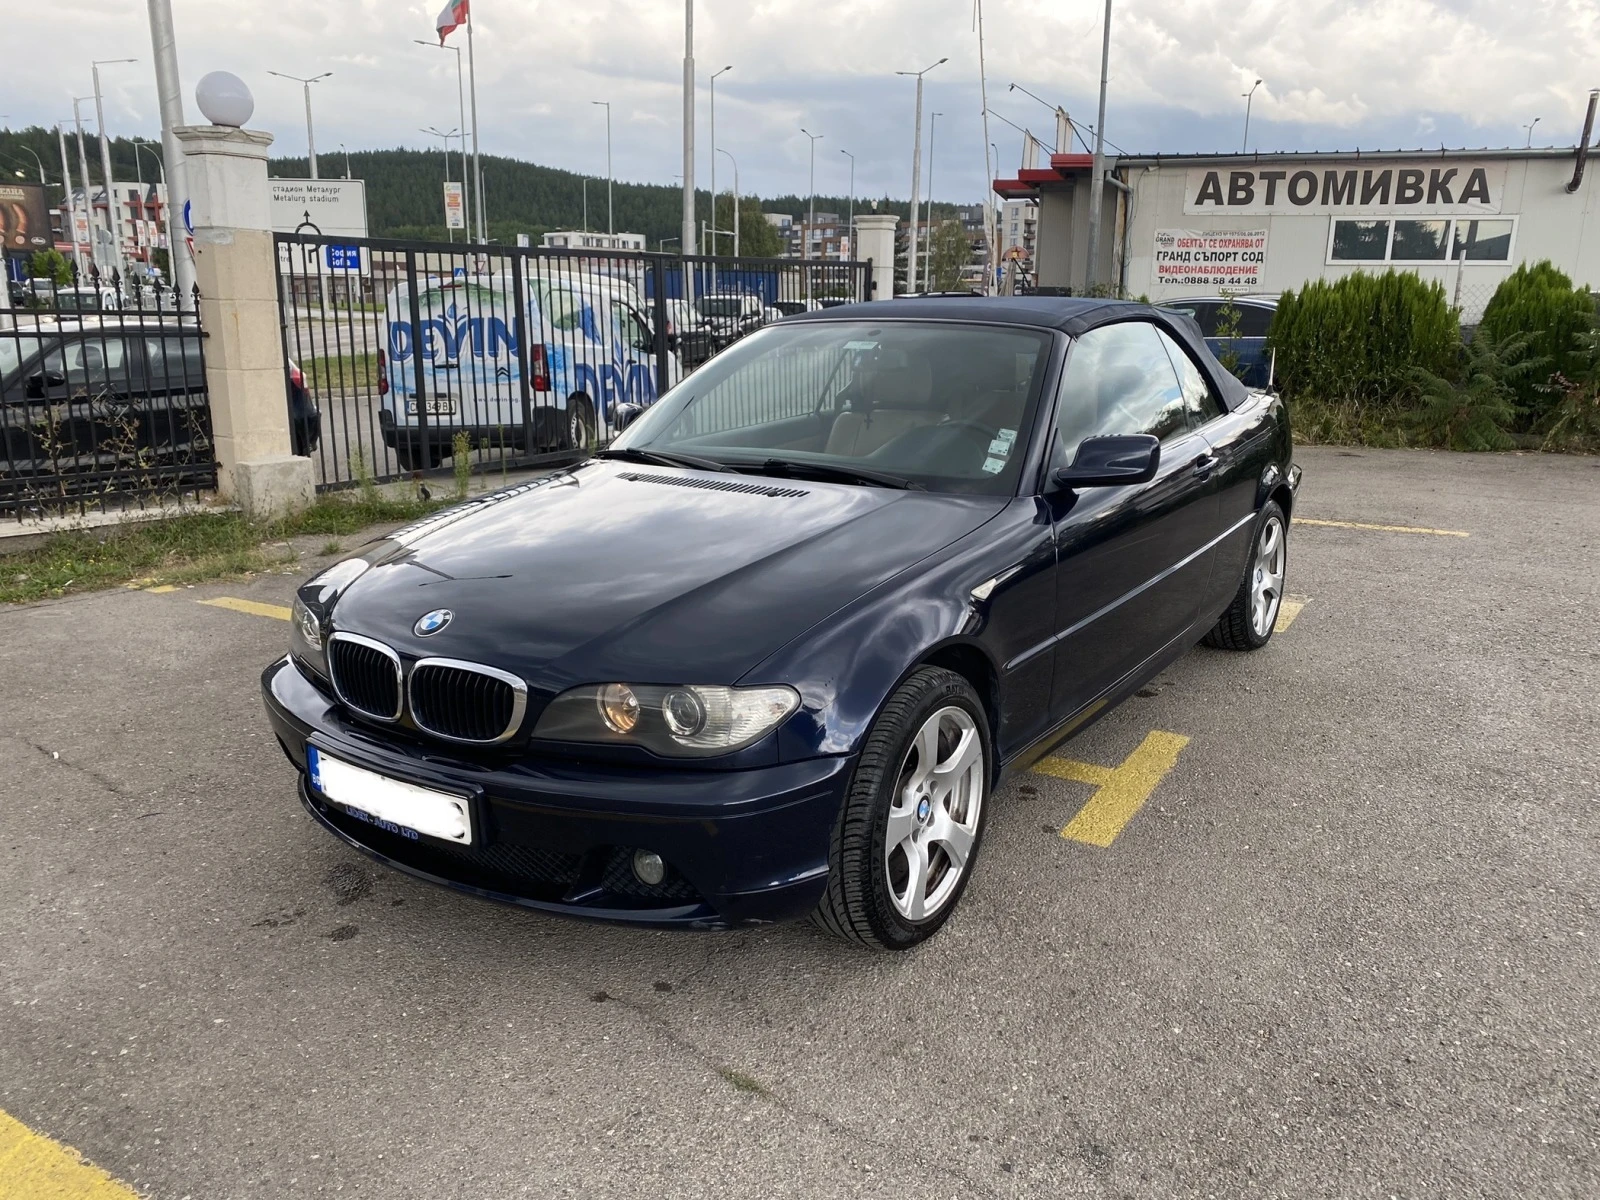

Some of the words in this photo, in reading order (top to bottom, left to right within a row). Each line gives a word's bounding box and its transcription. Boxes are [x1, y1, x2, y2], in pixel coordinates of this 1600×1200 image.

[306, 186, 341, 194] Металург
[1195, 168, 1491, 206] АВТОМИВКА
[273, 194, 306, 203] Metalurg
[1177, 238, 1207, 248] ОБЕКТЪТ
[1208, 239, 1217, 248] СЕ
[1218, 238, 1253, 248] ОХРАНЯВА
[1255, 238, 1264, 248] ОТ
[1156, 251, 1191, 263] ГРАНД
[1194, 251, 1238, 262] СЪПОРТ
[1241, 251, 1264, 263] СОД
[1158, 265, 1258, 275] ВИДЕОНАБЛЮДЕНИЕ
[1244, 277, 1257, 285] 48
[389, 314, 520, 361] DEVIN
[401, 826, 419, 840] LTD
